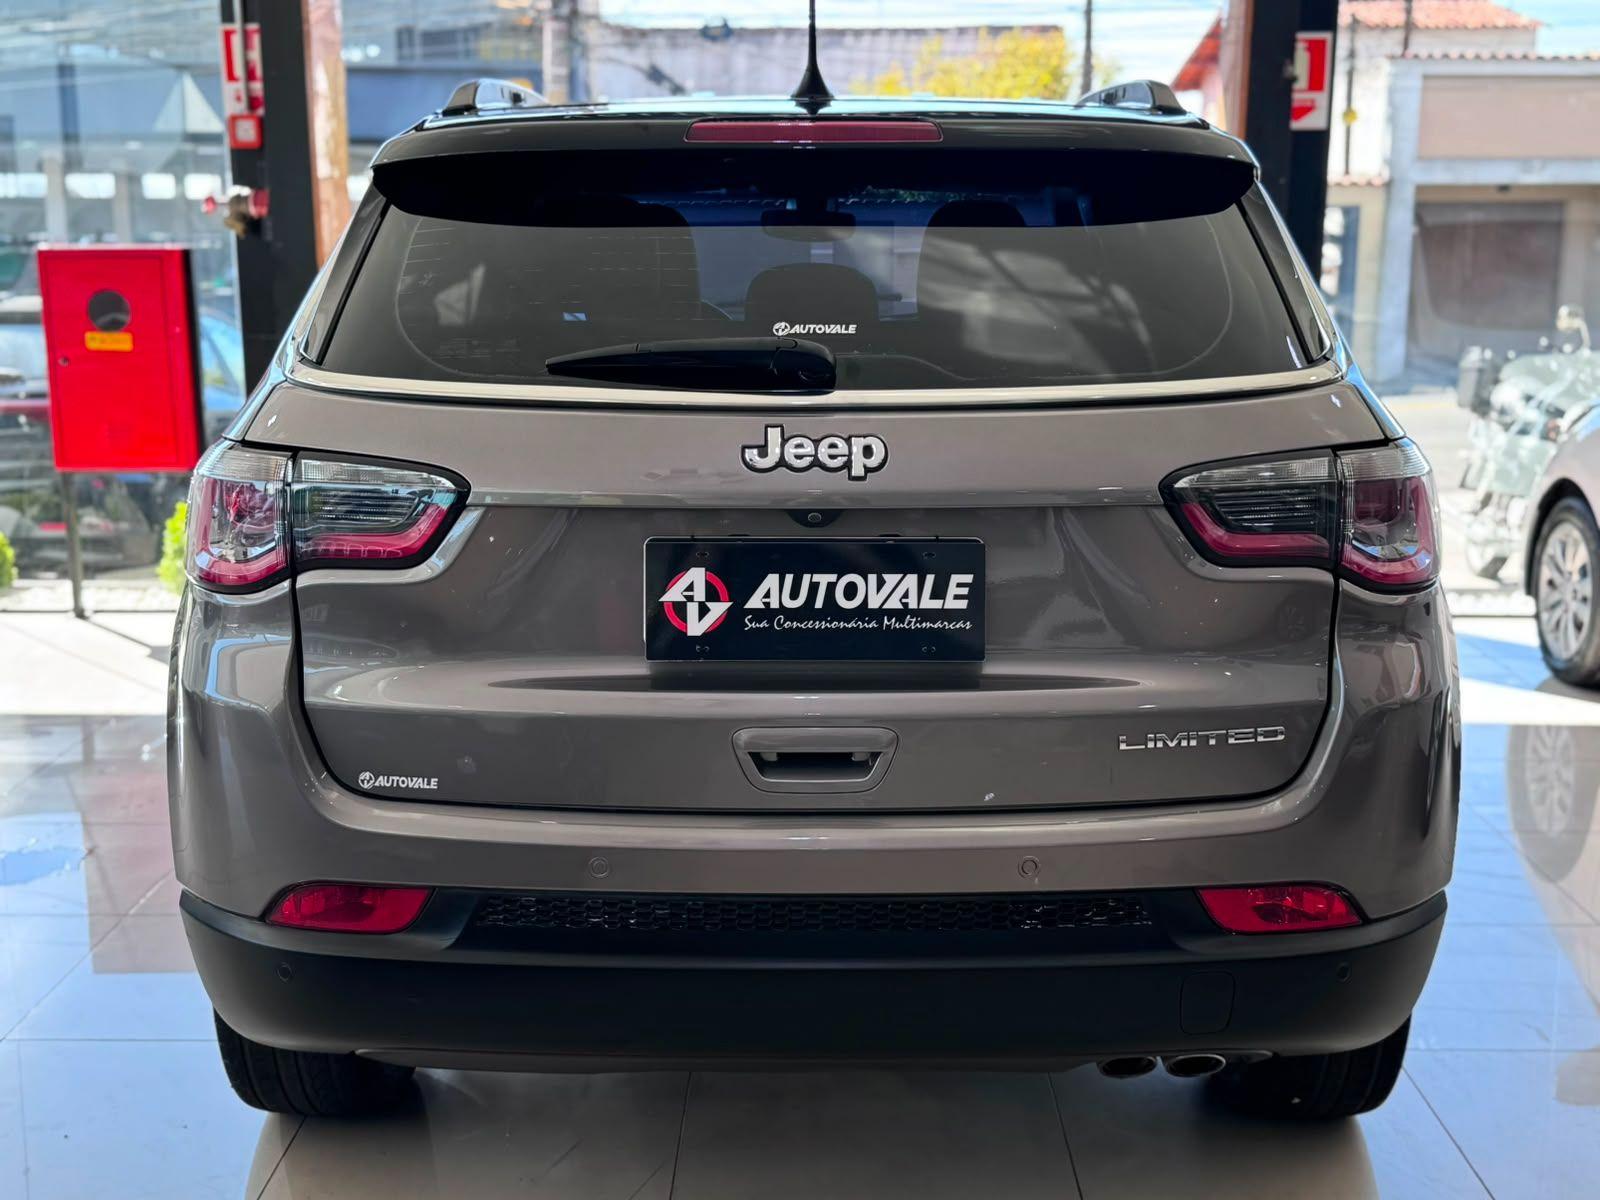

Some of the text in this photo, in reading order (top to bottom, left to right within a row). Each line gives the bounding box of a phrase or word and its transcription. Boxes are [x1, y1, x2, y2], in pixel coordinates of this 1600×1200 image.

[789, 324, 857, 334] AUTOVALE
[742, 424, 889, 481] Jeep
[743, 573, 974, 609] AUTOVALE
[744, 615, 973, 630] Sua Concessionária Multimarcas
[1119, 726, 1286, 750] LIMITED
[374, 775, 438, 789] AUTOVALE
